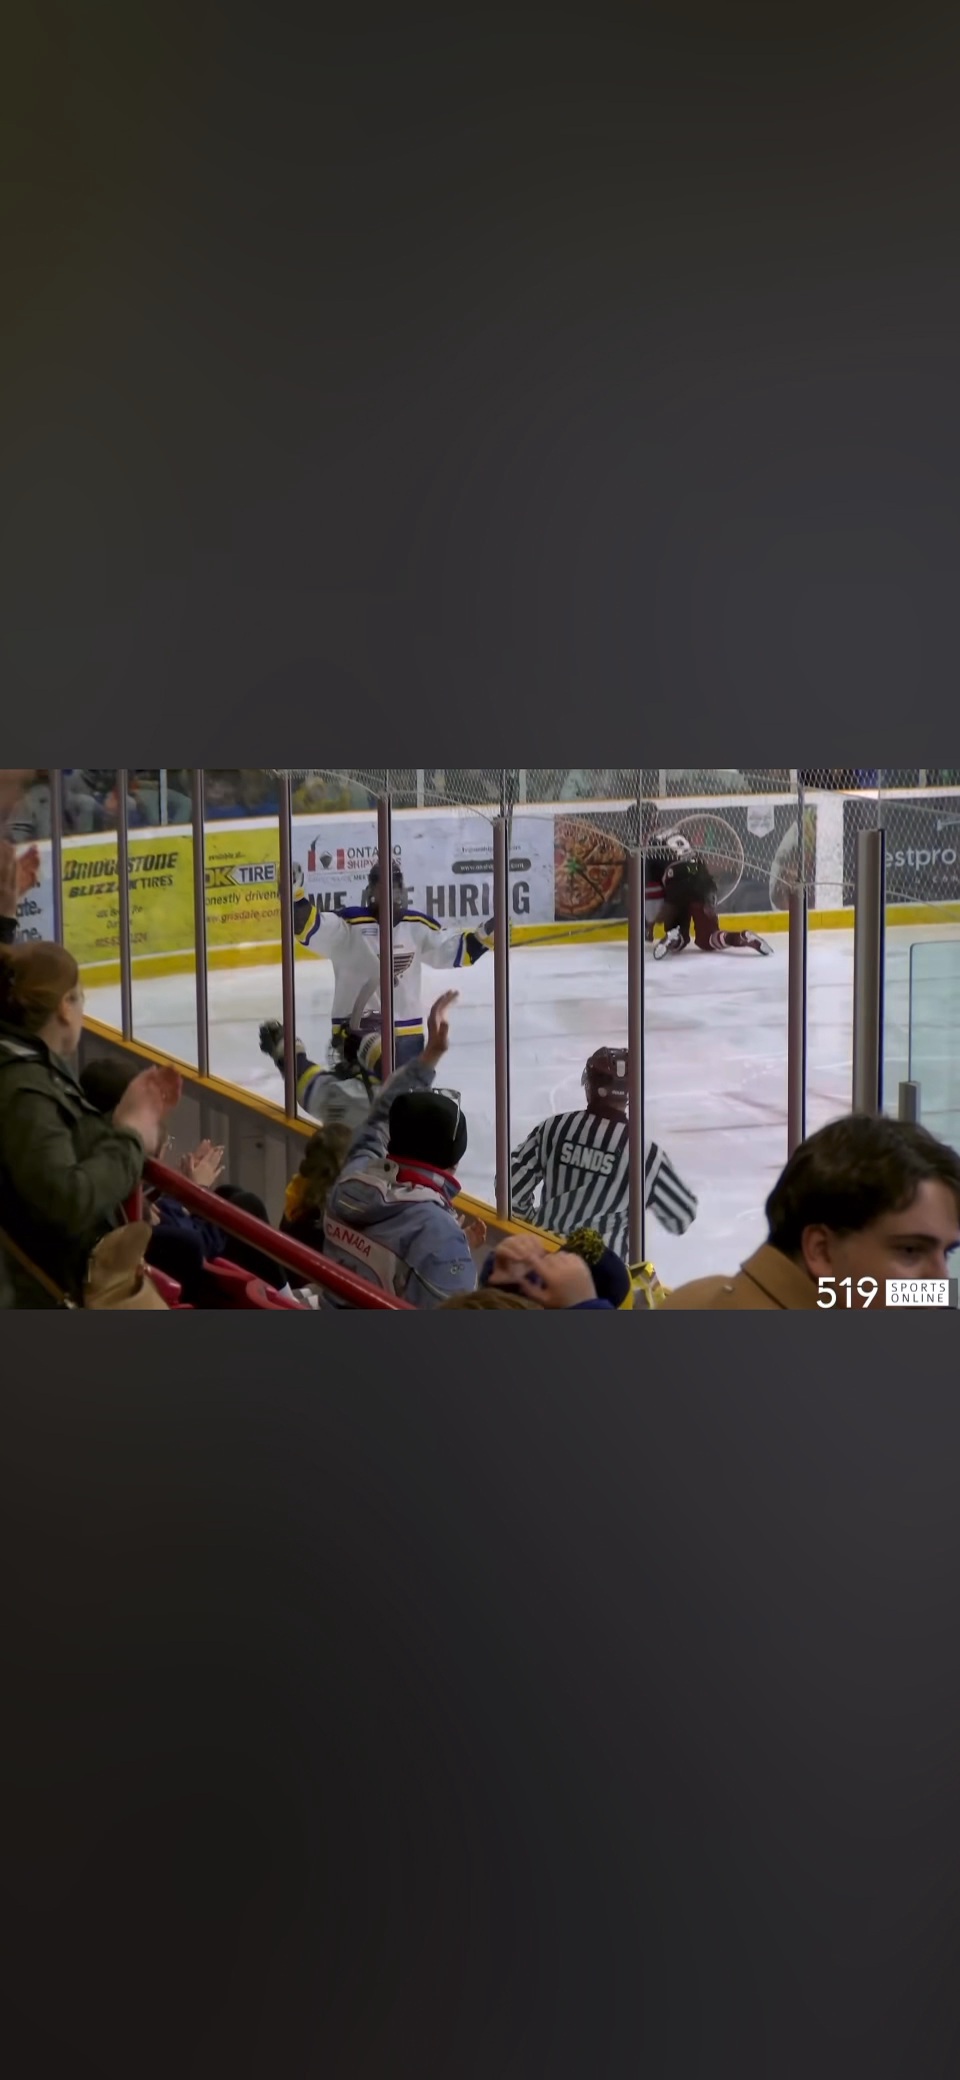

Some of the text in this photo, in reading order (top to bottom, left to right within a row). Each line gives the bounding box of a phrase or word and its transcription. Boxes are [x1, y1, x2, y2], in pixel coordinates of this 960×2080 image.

[347, 845, 402, 859] ONTAO
[885, 846, 957, 871] estpro
[63, 852, 178, 881] BRIDGSTONE
[239, 865, 275, 882] TIRE
[69, 880, 137, 898] BLIZZK
[205, 892, 240, 906] onestly
[425, 881, 530, 918] HIRIG
[308, 891, 347, 911] WE
[560, 1142, 616, 1176] SANDS
[325, 1223, 371, 1257] CANADA
